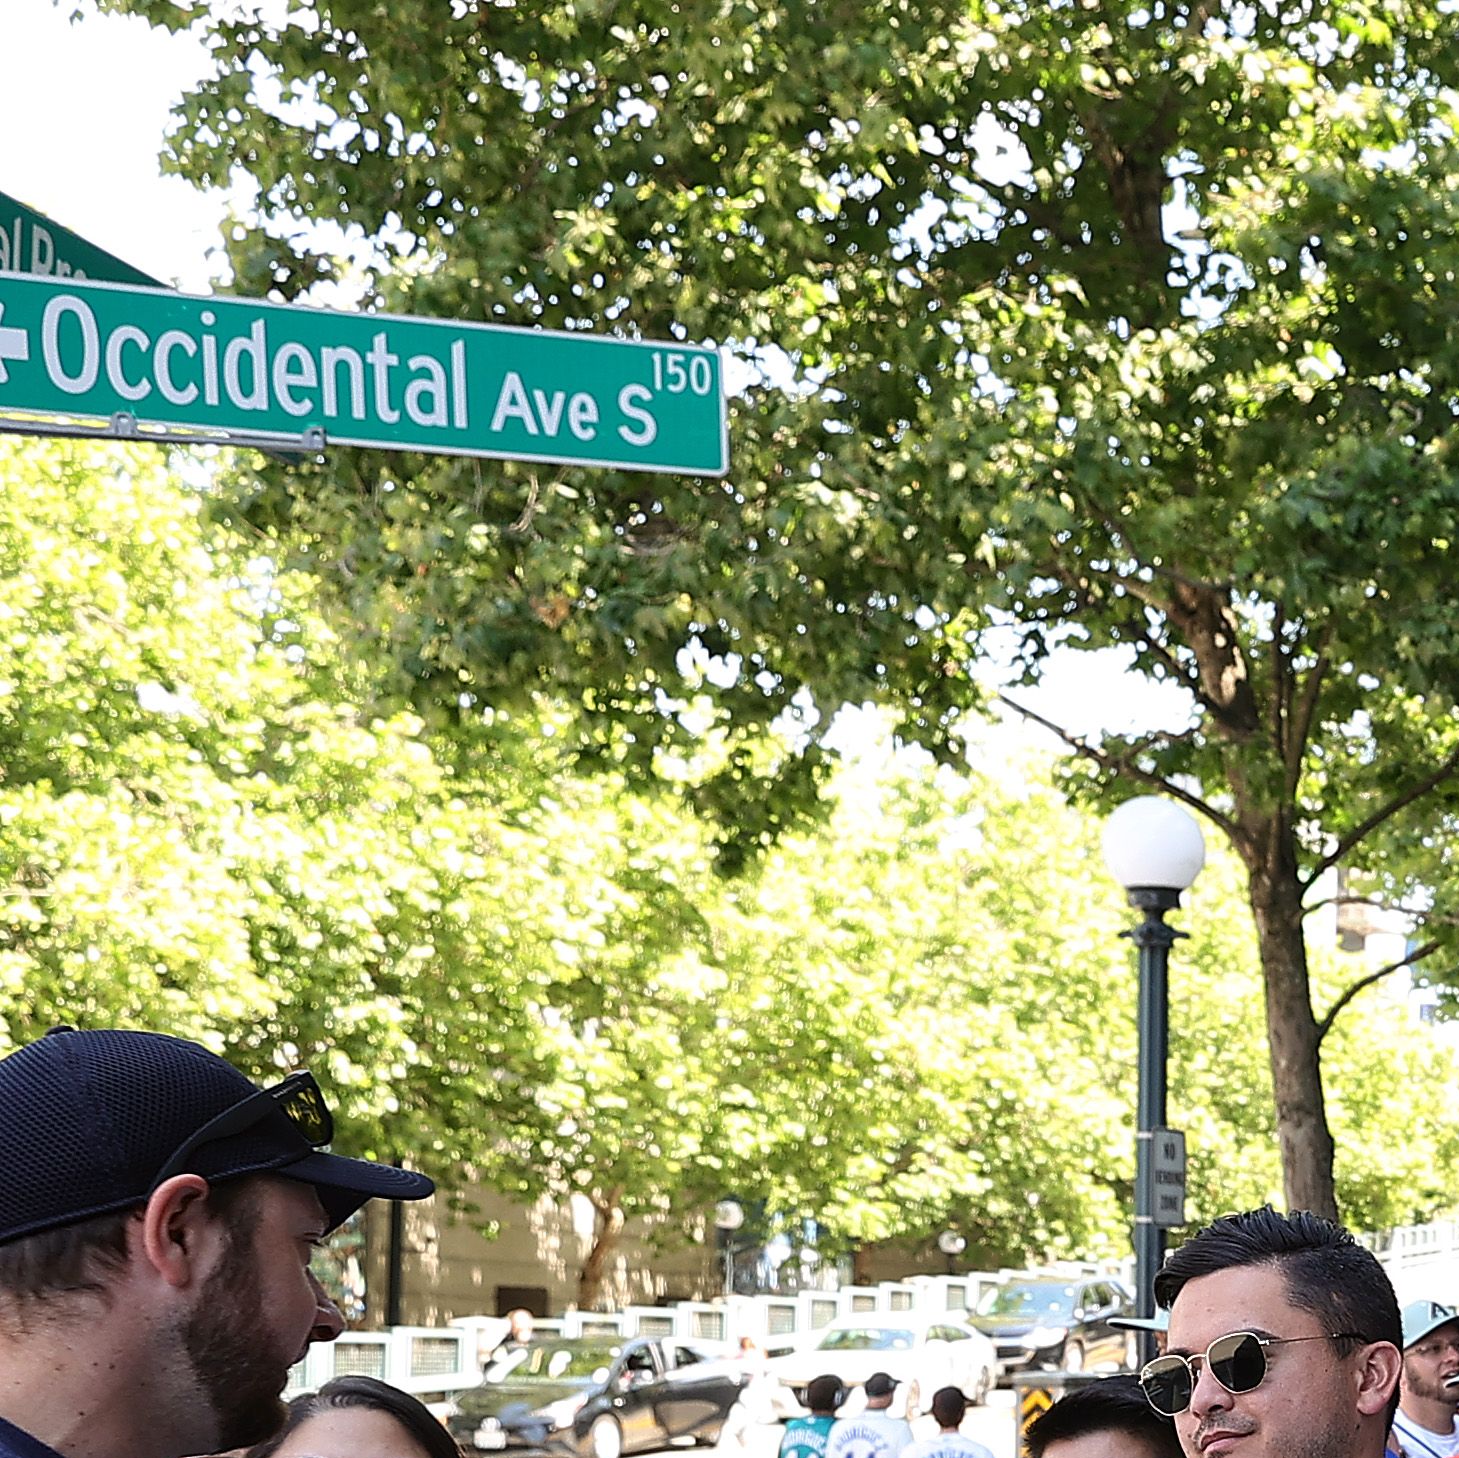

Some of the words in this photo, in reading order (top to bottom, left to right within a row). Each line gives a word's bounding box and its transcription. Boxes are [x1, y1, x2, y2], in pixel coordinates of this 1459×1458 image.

[41, 295, 468, 430] Occidental
[490, 372, 599, 442] Ave
[617, 382, 657, 446] S
[650, 351, 712, 396] 150
[1164, 1143, 1175, 1160] NO
